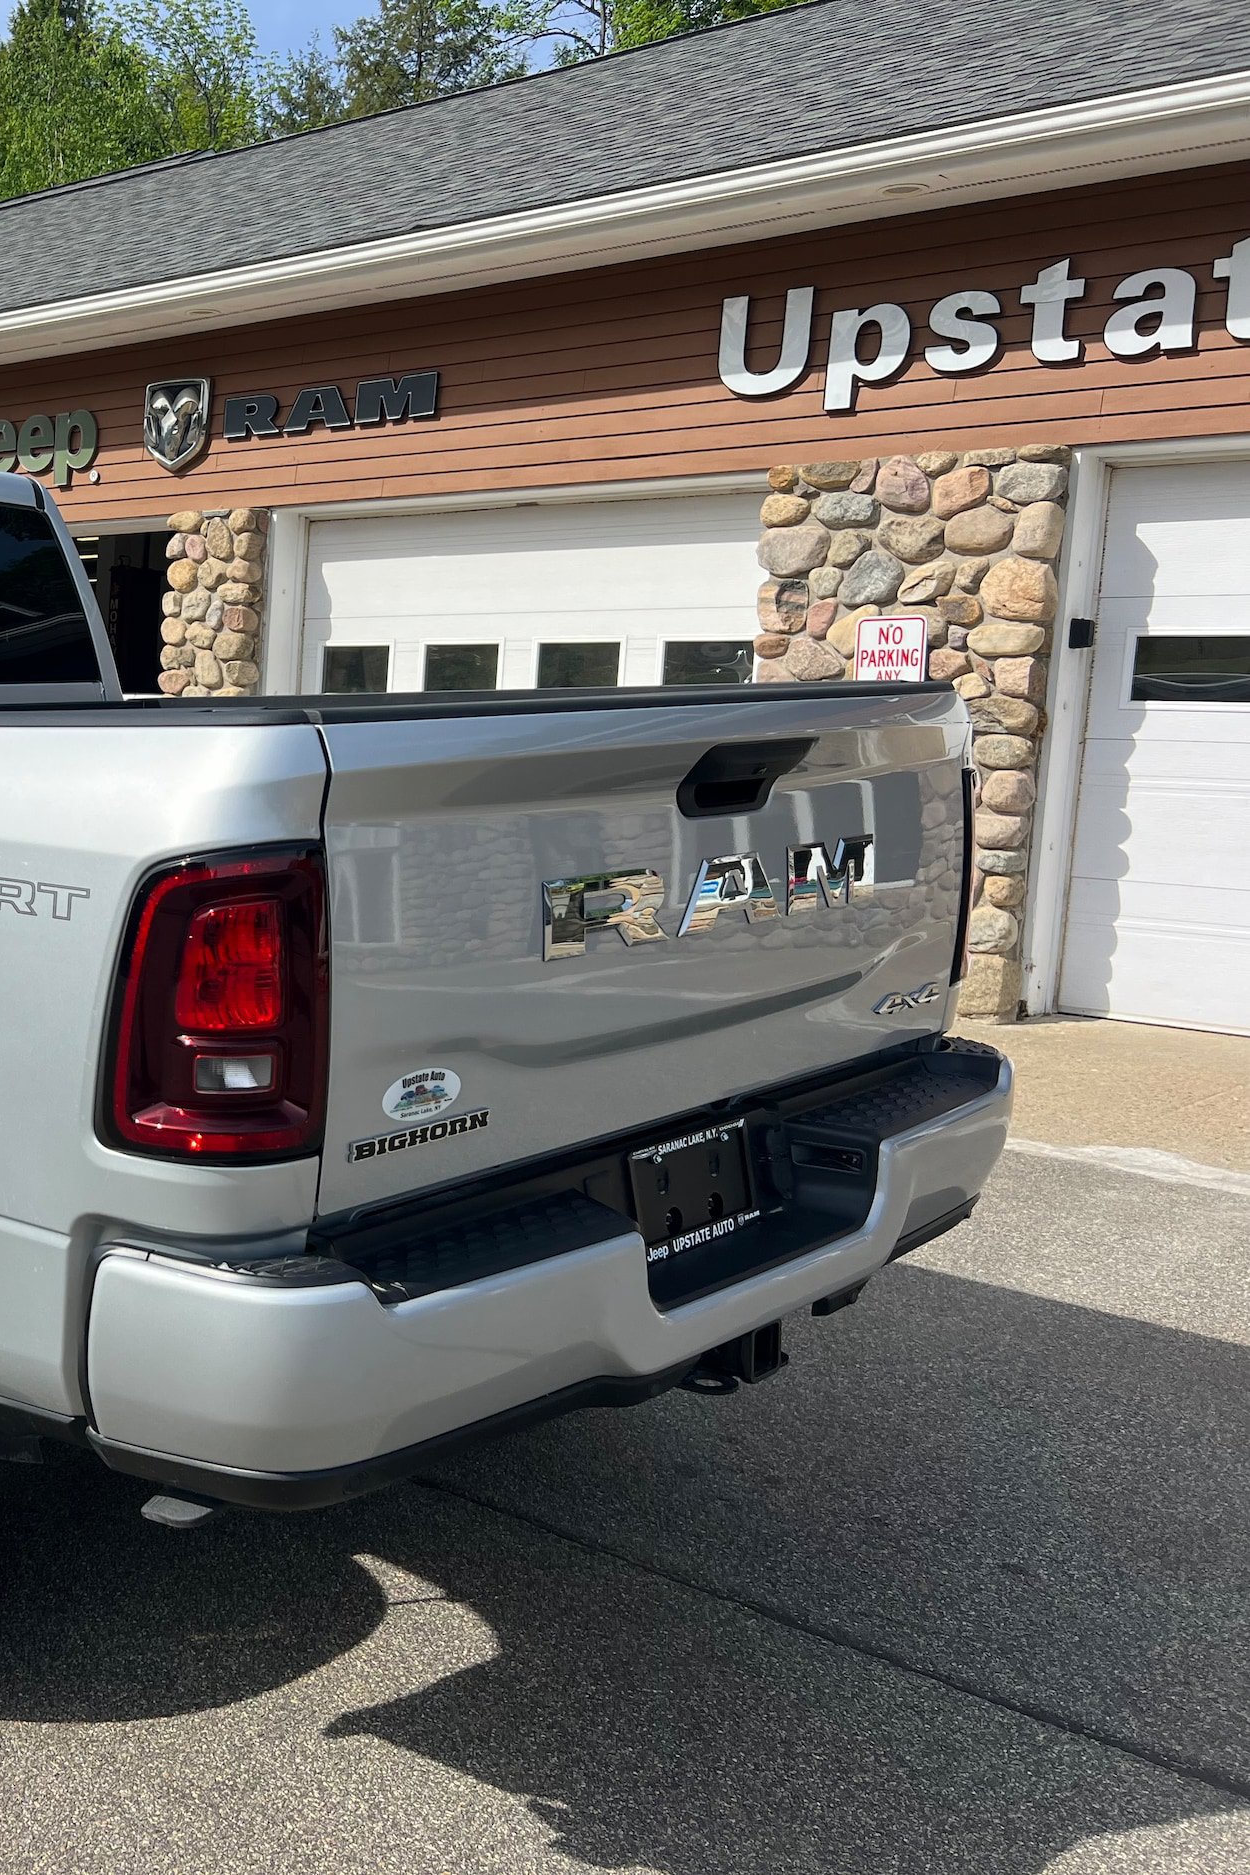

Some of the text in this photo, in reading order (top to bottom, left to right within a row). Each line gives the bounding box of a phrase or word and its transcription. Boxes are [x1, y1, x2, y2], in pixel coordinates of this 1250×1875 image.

[223, 371, 439, 438] RAM
[878, 626, 903, 645] NO
[860, 649, 919, 667] PARKING
[876, 670, 901, 680] ANY
[542, 834, 875, 962] RAM
[401, 1070, 446, 1089] Upstate Auto
[352, 1110, 490, 1163] BIGHORN
[657, 1128, 718, 1155] SARANAC LAKE, N.Y.
[672, 1218, 735, 1252] UPSTATE AUTO
[647, 1246, 669, 1262] Jeep
